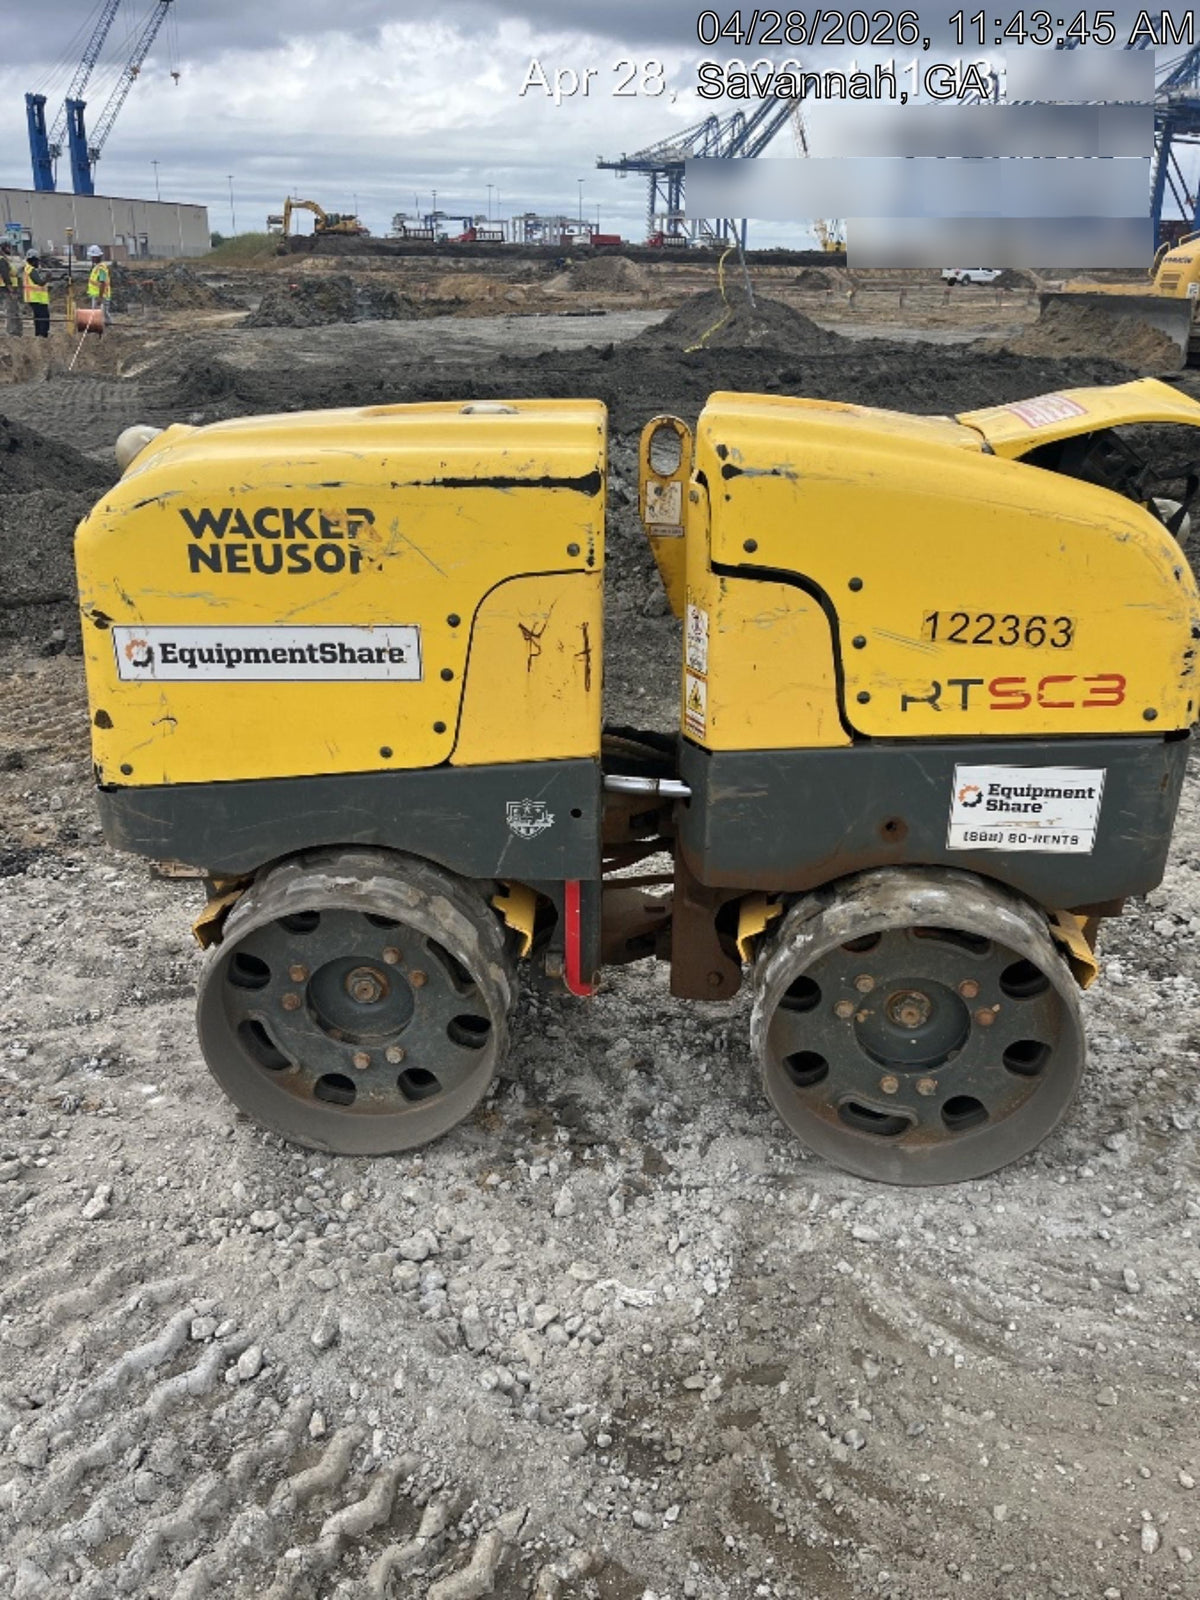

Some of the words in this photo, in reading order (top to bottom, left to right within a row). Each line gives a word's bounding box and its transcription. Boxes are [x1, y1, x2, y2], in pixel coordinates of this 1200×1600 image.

[925, 611, 1073, 648] 122363
[158, 642, 405, 668] EquipmentShare
[987, 783, 1096, 800] Equipment
[985, 799, 1043, 813] Share
